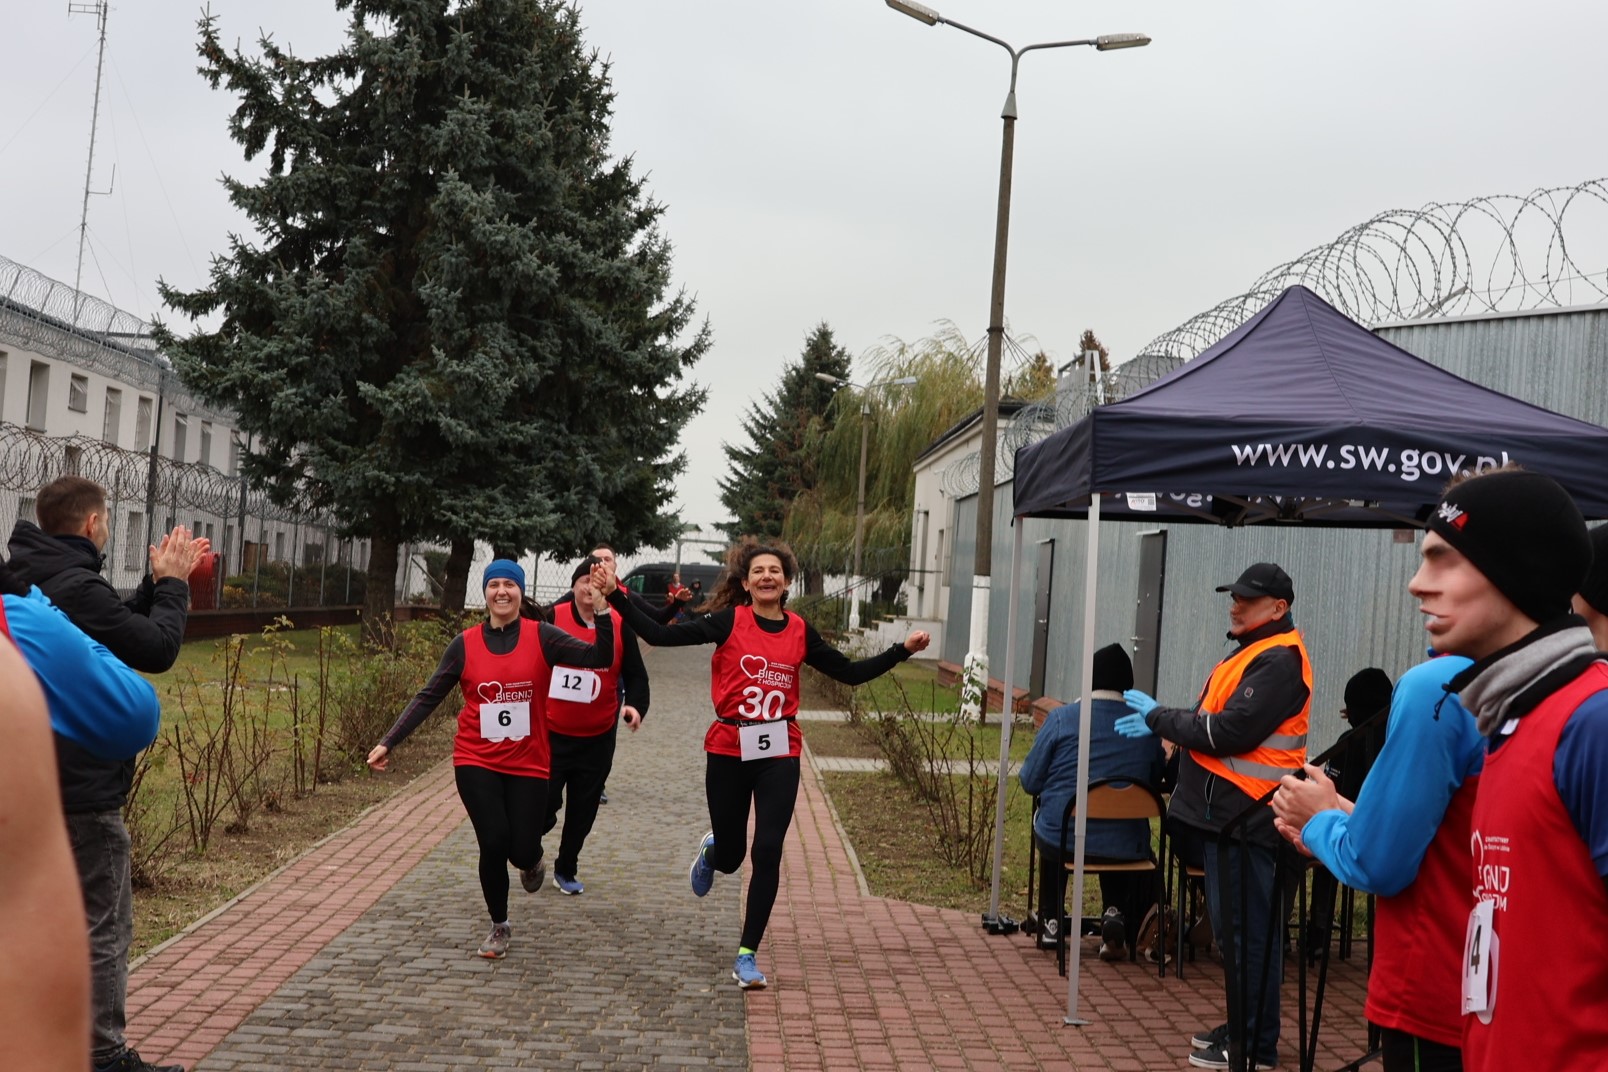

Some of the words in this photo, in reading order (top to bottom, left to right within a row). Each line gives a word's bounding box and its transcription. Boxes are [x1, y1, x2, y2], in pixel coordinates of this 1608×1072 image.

[561, 674, 582, 690] 12
[757, 669, 793, 683] BIEGNIJ
[496, 690, 533, 702] BIEGNIJ
[738, 686, 785, 720] 30
[498, 710, 512, 727] 6
[758, 734, 771, 750] 5
